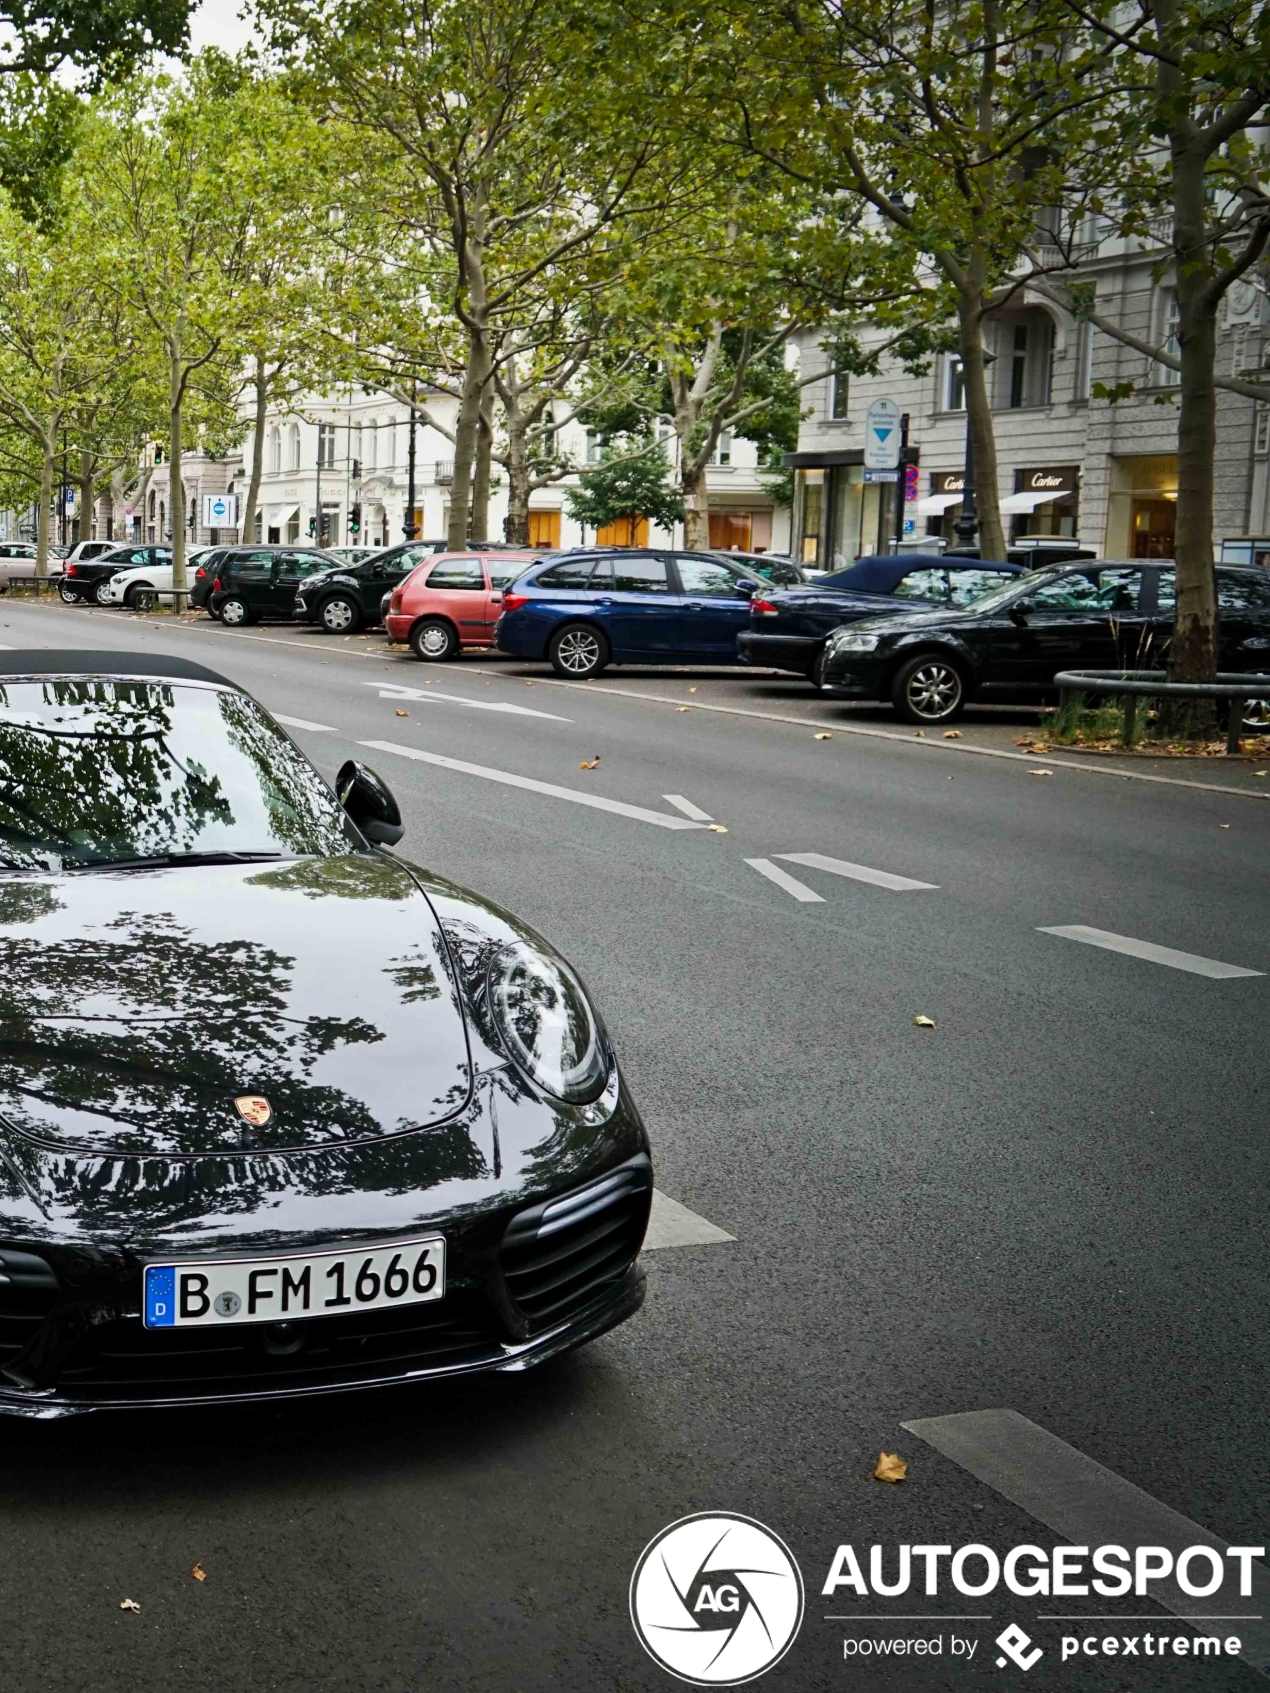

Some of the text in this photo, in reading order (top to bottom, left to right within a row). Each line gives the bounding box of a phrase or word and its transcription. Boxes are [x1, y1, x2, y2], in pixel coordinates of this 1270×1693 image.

[944, 476, 965, 490] Carti
[1031, 473, 1063, 487] Cartier
[155, 1250, 437, 1319] D B FM 1666
